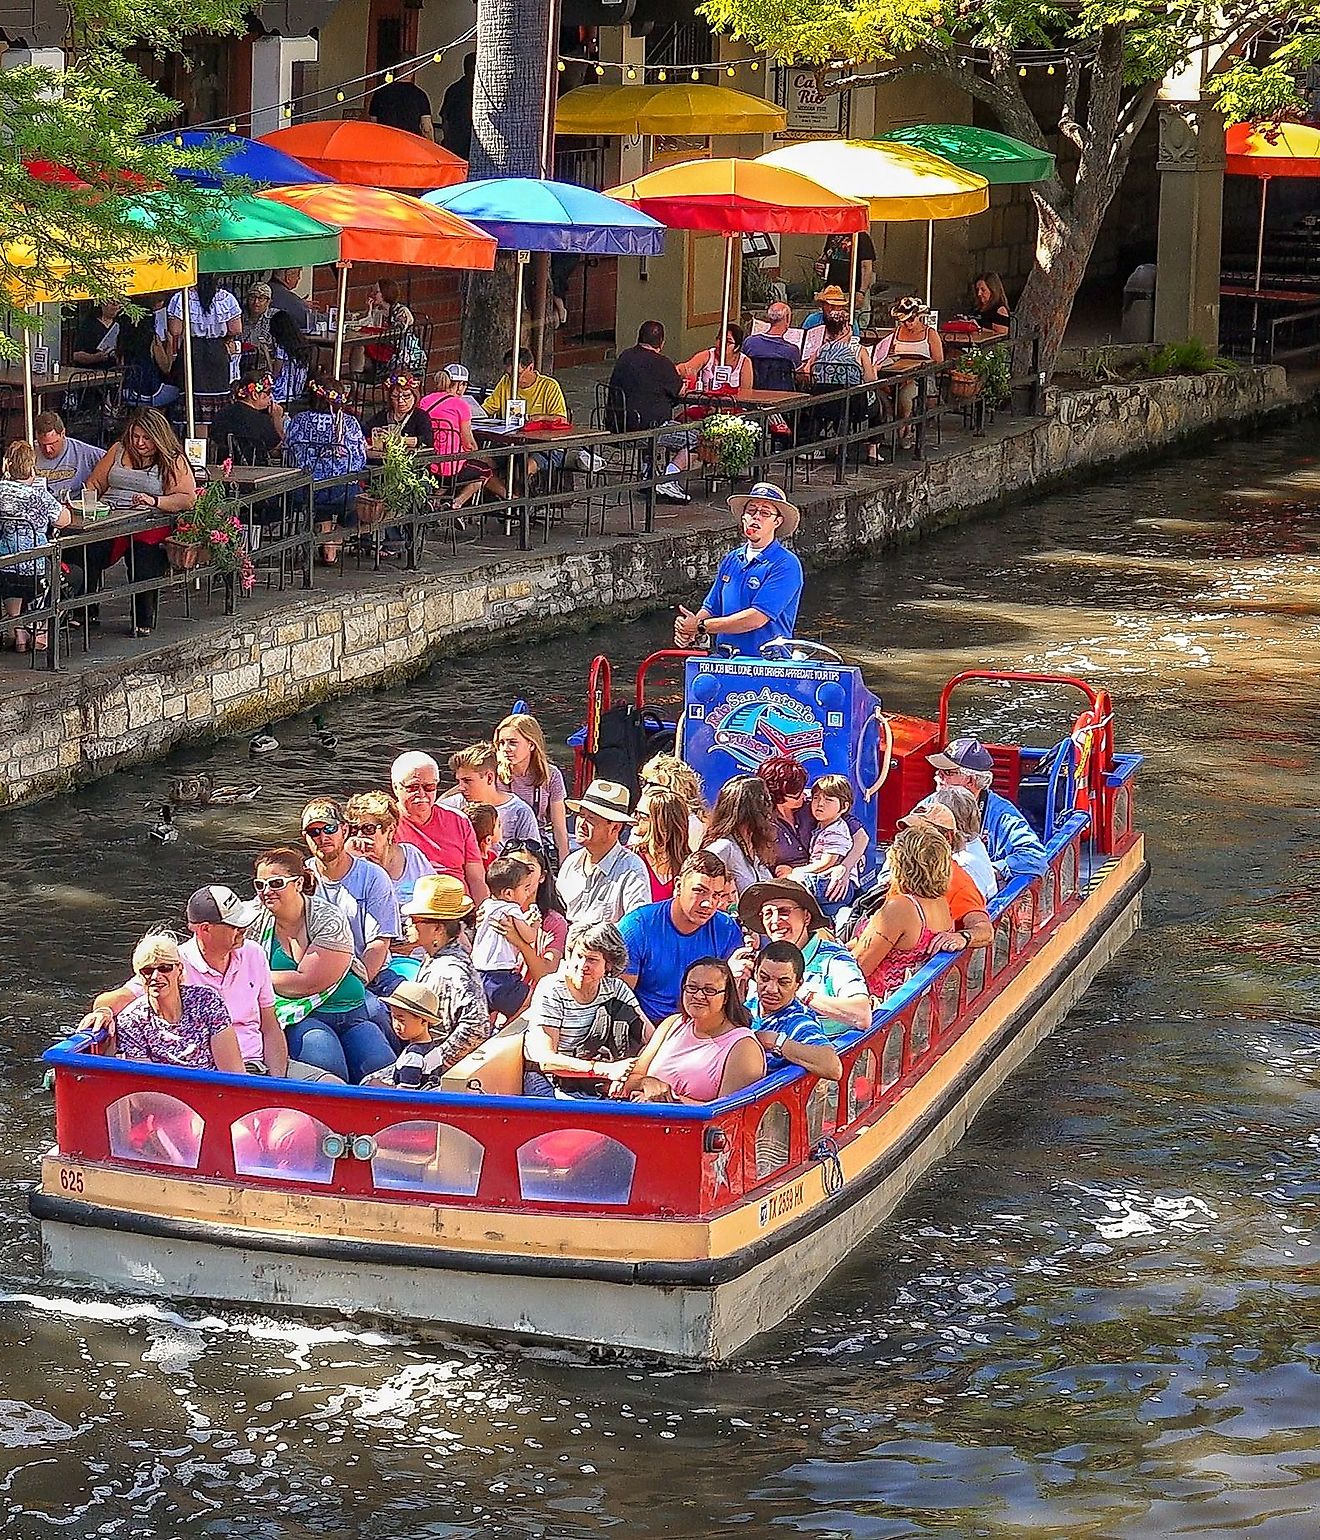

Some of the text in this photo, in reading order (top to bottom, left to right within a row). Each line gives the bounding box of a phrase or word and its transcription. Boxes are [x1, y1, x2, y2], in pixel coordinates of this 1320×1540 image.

[699, 662, 710, 673] FOR
[715, 664, 724, 674] JOB
[753, 666, 764, 676] OUR
[829, 671, 840, 682] TIPS
[726, 690, 757, 708] San
[757, 687, 815, 723] Antonio
[715, 731, 771, 754] Cruises
[60, 1168, 84, 1194] 625
[769, 1195, 777, 1220] TX
